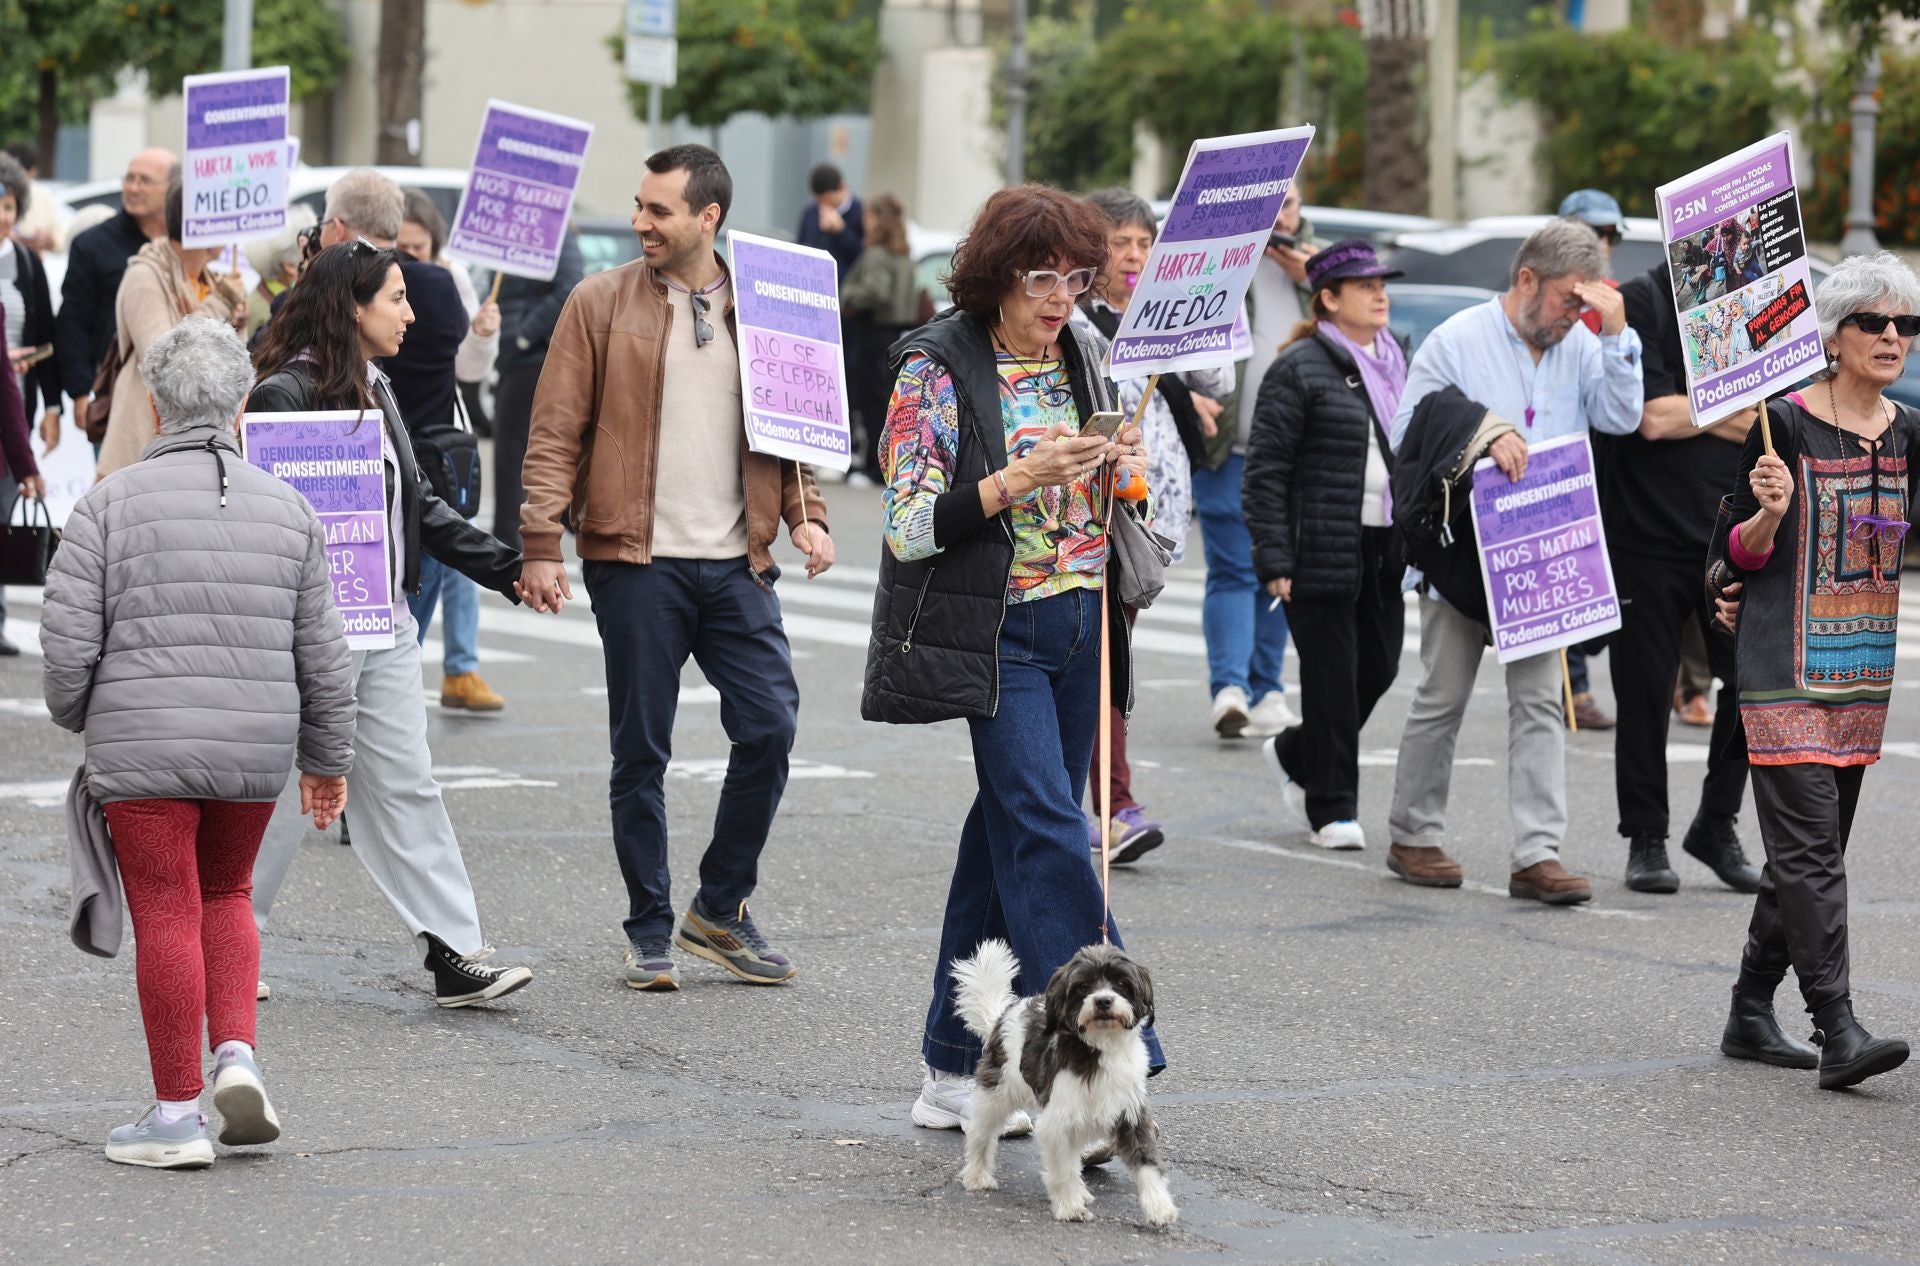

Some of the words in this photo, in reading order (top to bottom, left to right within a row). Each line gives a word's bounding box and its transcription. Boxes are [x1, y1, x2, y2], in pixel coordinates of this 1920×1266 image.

[204, 102, 287, 125] CONSENTIMIENTO
[194, 156, 233, 178] HARTA
[248, 150, 277, 169] VIVIR
[475, 175, 510, 197] NOS
[513, 184, 564, 210] MATAN
[1176, 191, 1198, 206] SIN
[1198, 178, 1292, 205] CONSENTIMIENTO
[1193, 169, 1258, 190] DENUNCIES
[1259, 168, 1266, 181] O
[1712, 183, 1731, 197] PONER
[1732, 179, 1742, 188] FIN
[1747, 162, 1772, 181] TODAS
[1721, 192, 1732, 201] LAS
[1732, 176, 1766, 197] VIOLENCIAS
[477, 195, 507, 220] POR
[512, 204, 543, 226] SER
[1674, 197, 1707, 224] 25N
[1714, 200, 1739, 214] CONTRA
[1739, 194, 1749, 204] LAS
[1750, 181, 1775, 198] MUJERES
[1759, 204, 1766, 212] La
[1767, 191, 1794, 208] violencia
[189, 219, 238, 235] Podemos
[239, 212, 284, 230] Córdoba
[1192, 205, 1209, 221] ES
[1760, 213, 1768, 221] de
[1769, 209, 1778, 218] las
[1761, 215, 1784, 232] guerras
[464, 213, 546, 248] MUJERES
[1763, 225, 1784, 242] golpea
[1764, 227, 1800, 249] doblemente
[453, 233, 505, 257] Podemos
[506, 247, 554, 270] Córdoba
[1154, 251, 1206, 283] HARTA
[1203, 259, 1216, 276] de
[1221, 243, 1256, 271] VIVIR
[1768, 251, 1792, 268] mujeres
[1771, 247, 1780, 256] las
[745, 264, 799, 288] DENUNCIES
[1189, 283, 1214, 296] con
[736, 277, 753, 292] SIN
[755, 281, 838, 312] CONSENTIMIENTO
[757, 297, 769, 310] ES
[1749, 296, 1787, 333] PONGAMOS
[1790, 283, 1803, 300] FIN
[1756, 332, 1768, 346] AL
[1770, 298, 1805, 332] GENOCIDIO
[754, 335, 780, 359] NO
[794, 344, 816, 365] SE
[1116, 337, 1176, 361] Podemos
[1177, 331, 1226, 354] Córdoba
[1696, 368, 1762, 408] Podemos
[1764, 340, 1818, 378] Córdoba
[754, 386, 777, 407] SE
[785, 391, 839, 424] LUCHA.
[752, 416, 800, 441] Podemos
[803, 427, 846, 452] Córdoba
[260, 446, 334, 461] DENUNCIES
[336, 445, 345, 460] O
[274, 460, 383, 478] CONSENTIMIENTO
[1495, 473, 1593, 512] CONSENTIMIENTO
[1499, 510, 1514, 524] ES
[1492, 544, 1533, 573] NOS
[1539, 526, 1591, 561] MATAN
[1505, 570, 1539, 596] POR
[1546, 556, 1580, 584] SER
[1502, 576, 1594, 620] MUJERES
[1500, 621, 1560, 649] Podemos
[1562, 603, 1616, 630] Córdoba
